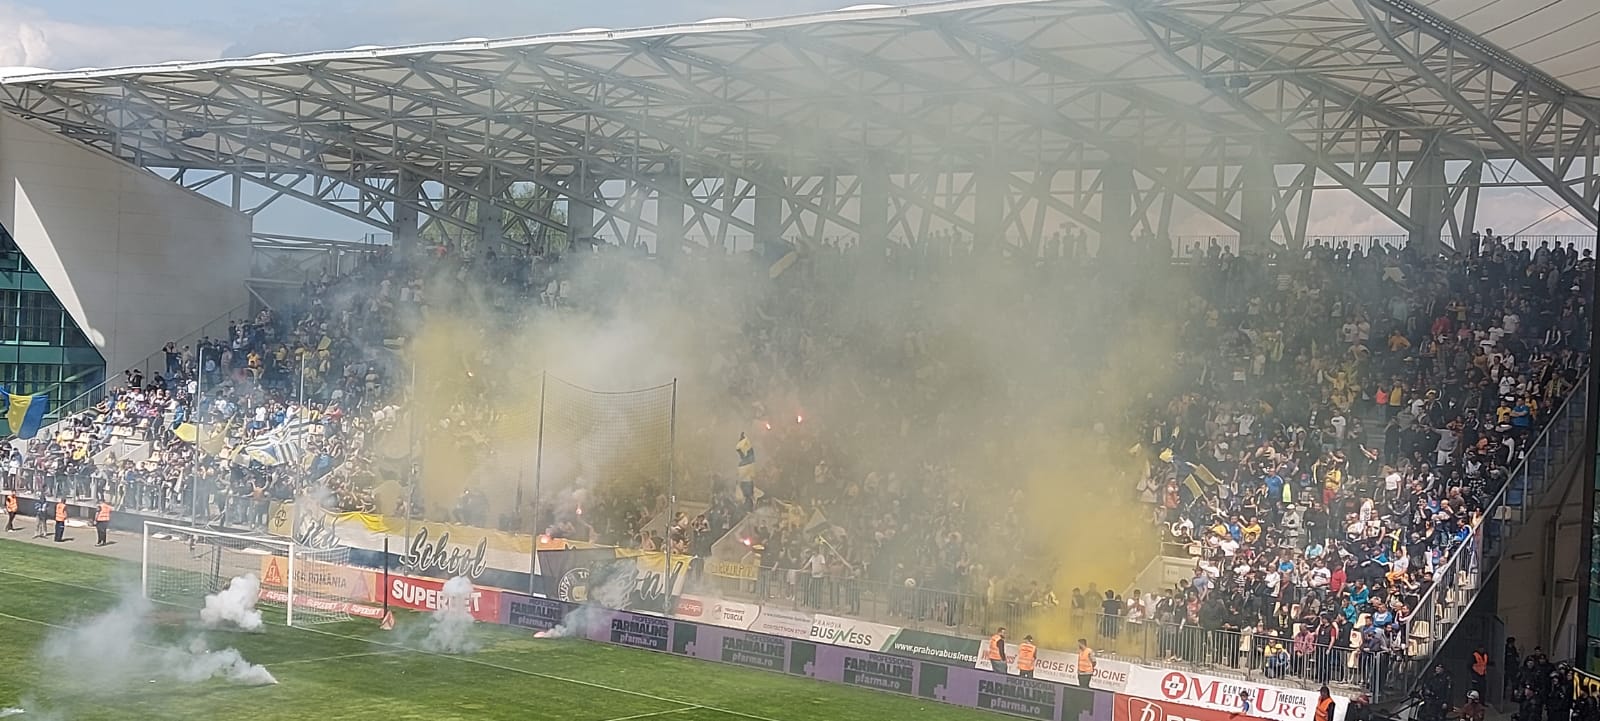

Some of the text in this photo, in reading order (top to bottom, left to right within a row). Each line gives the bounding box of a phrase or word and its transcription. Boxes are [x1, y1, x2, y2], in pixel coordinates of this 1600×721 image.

[399, 527, 487, 578] School
[392, 579, 481, 612] SUPERET
[810, 626, 873, 646] BUSINESS
[732, 652, 773, 667] pfarma.ro
[844, 656, 913, 680] FARMALINE
[1065, 663, 1075, 673] IS
[855, 673, 900, 690] pfarma.ro
[1222, 683, 1307, 706] CENTUL MEDICAL
[991, 698, 1041, 715] pfarma.ro
